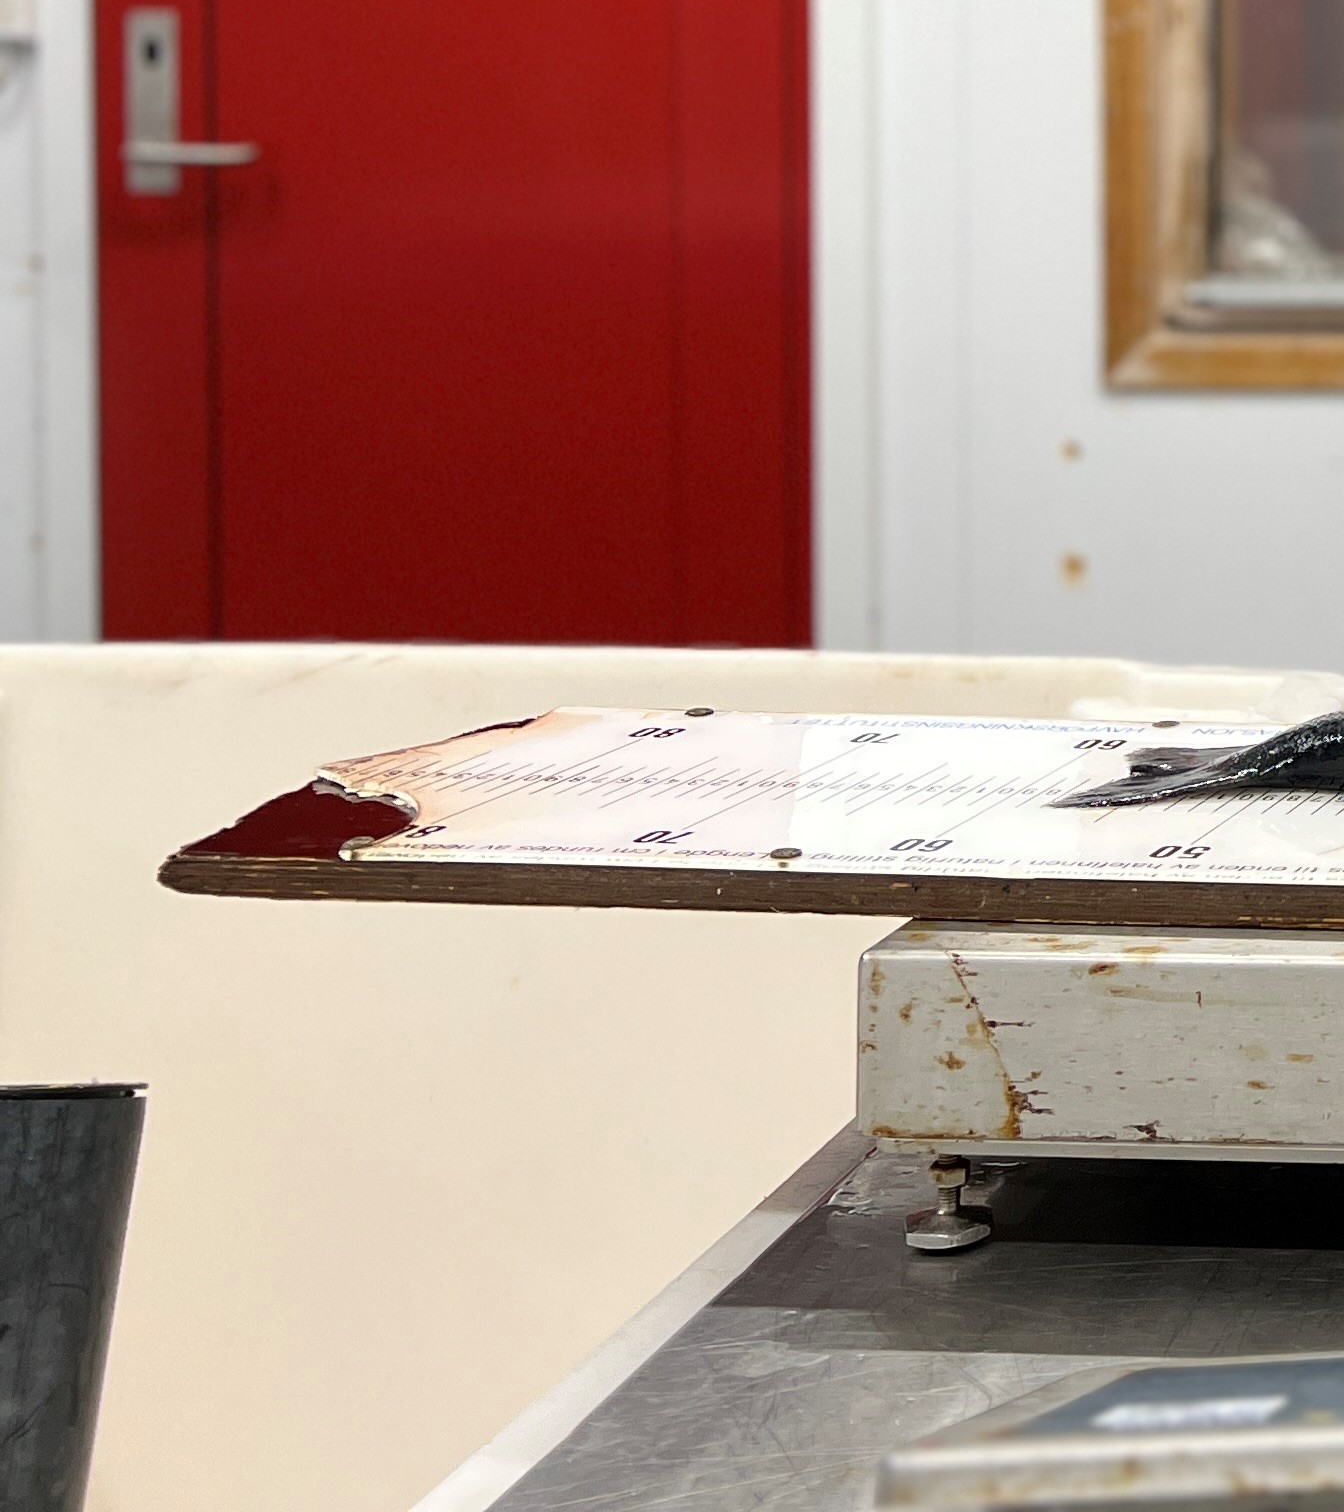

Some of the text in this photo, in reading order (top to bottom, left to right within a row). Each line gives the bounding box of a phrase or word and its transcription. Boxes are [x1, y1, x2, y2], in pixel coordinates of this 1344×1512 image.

[628, 727, 686, 738] 80
[850, 733, 901, 743] 70
[1073, 739, 1127, 750] 60
[632, 830, 695, 844] 70
[518, 845, 604, 853] rundes
[889, 838, 954, 853] 60
[673, 849, 771, 860] Lengde
[1148, 845, 1212, 859] 50
[904, 855, 1005, 865] naturlig
[1029, 860, 1164, 870] halefinnen
[1208, 863, 1288, 872] enden
